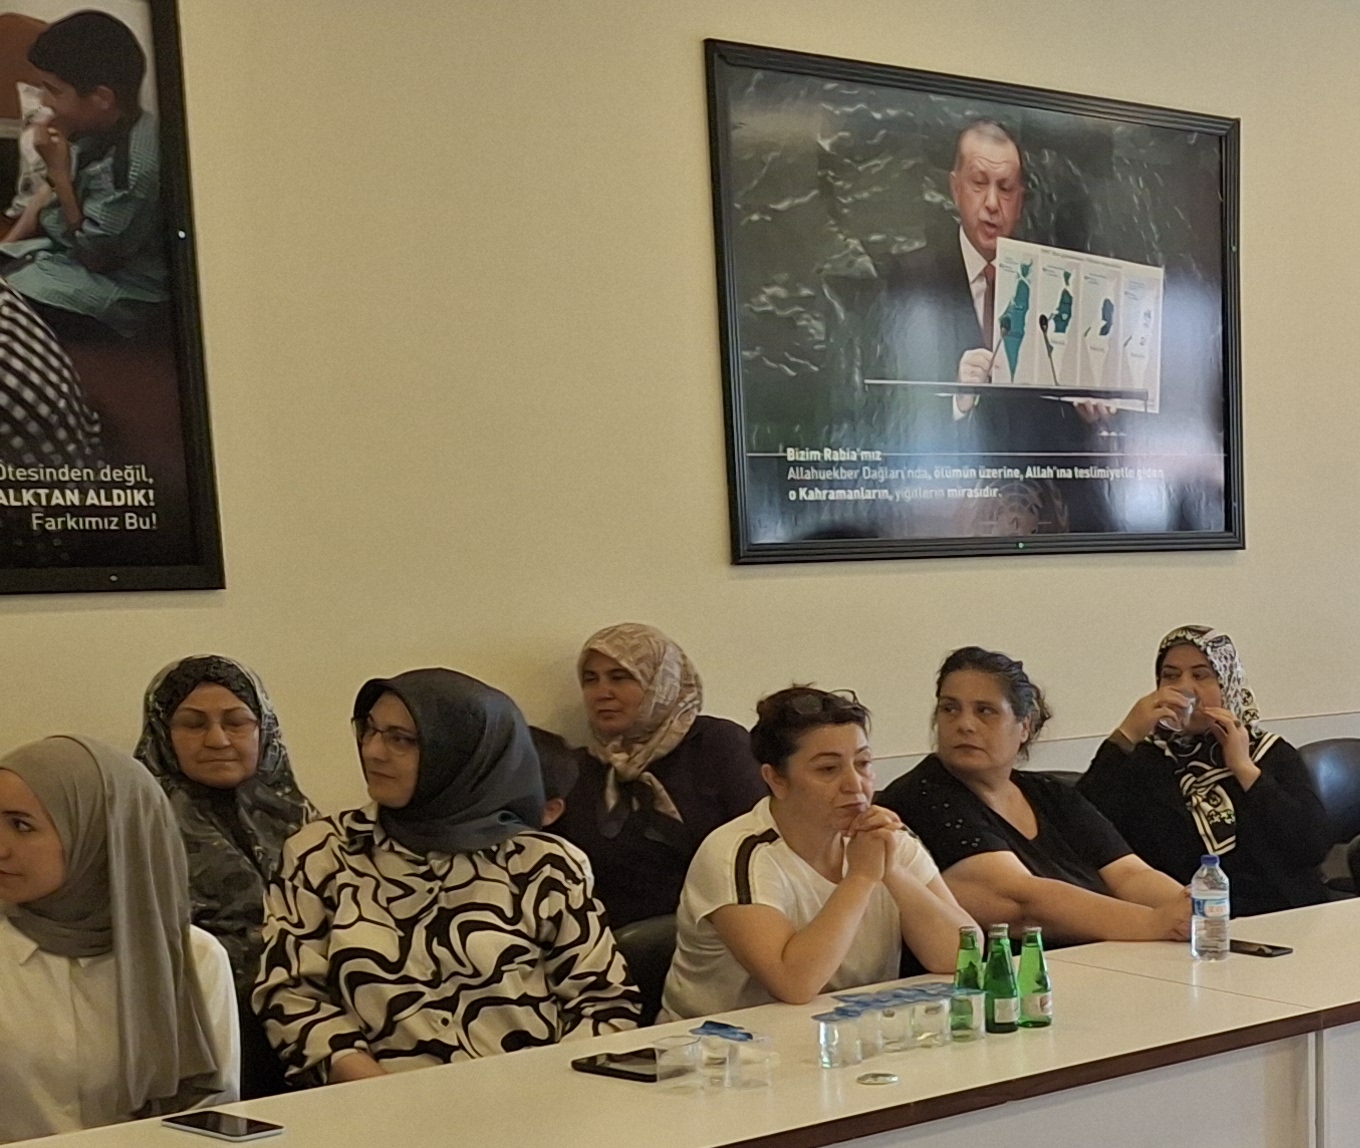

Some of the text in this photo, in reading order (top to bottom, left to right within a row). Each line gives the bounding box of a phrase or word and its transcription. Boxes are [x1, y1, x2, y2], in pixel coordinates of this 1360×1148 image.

[786, 447, 821, 462] Bizim
[787, 466, 860, 481] Allahuekber
[85, 489, 155, 507] ALDIK!
[788, 491, 797, 501] o
[31, 512, 157, 531] Farkımız Bu!
